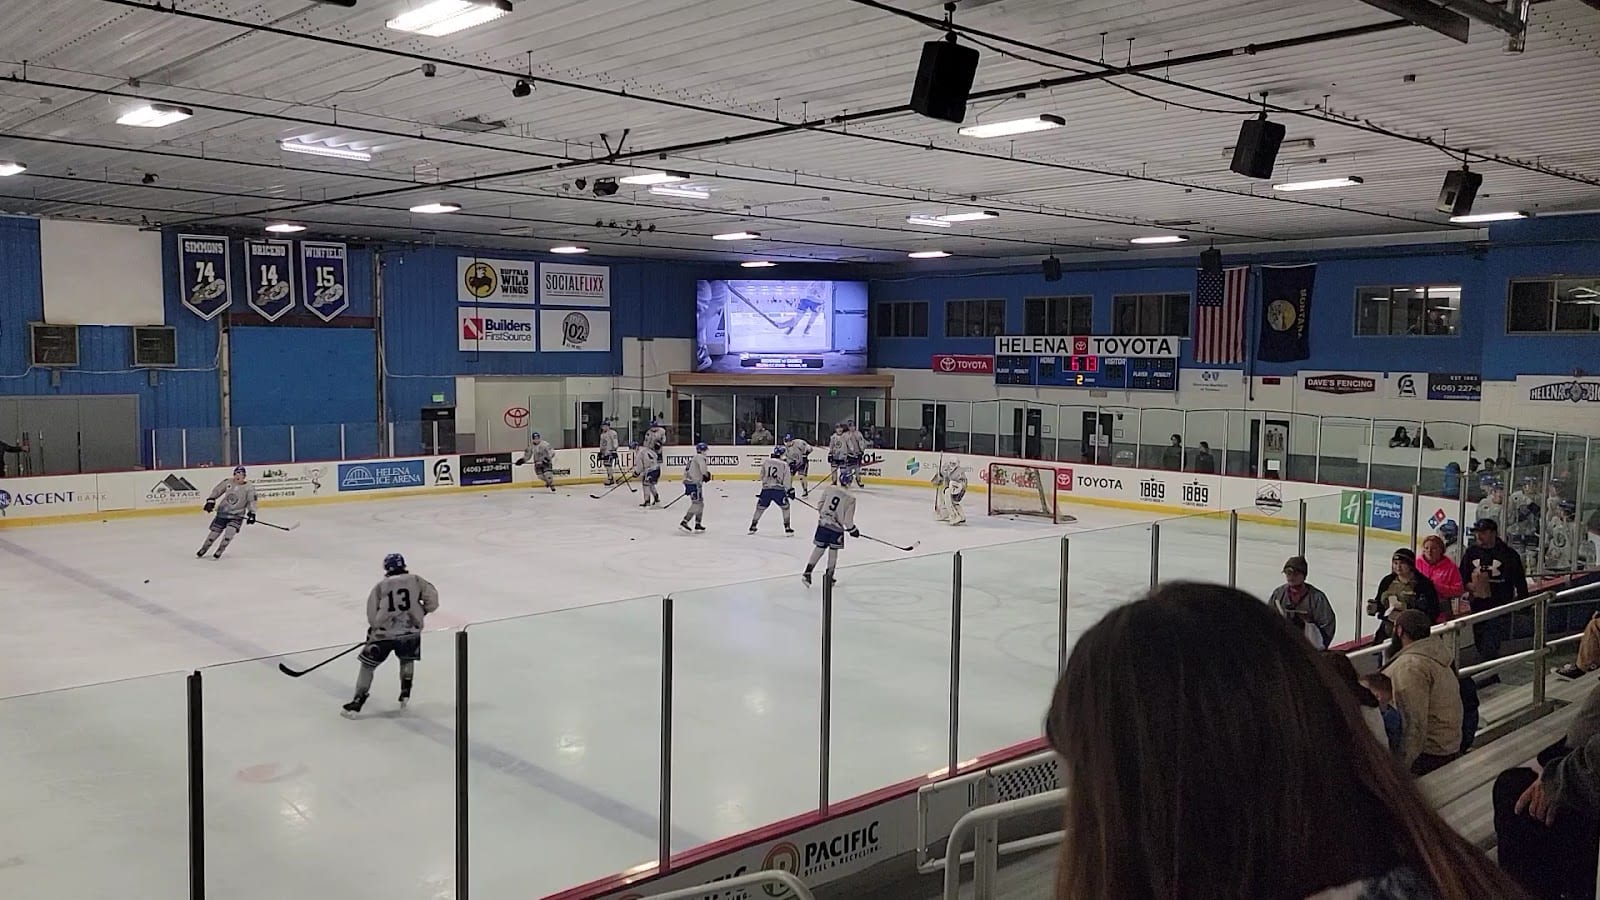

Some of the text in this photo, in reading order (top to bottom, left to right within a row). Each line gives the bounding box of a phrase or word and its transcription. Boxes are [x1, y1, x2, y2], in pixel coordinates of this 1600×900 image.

[184, 240, 224, 255] SIMMONS
[305, 246, 343, 260] WINFIELD
[195, 261, 215, 283] 74
[260, 264, 278, 286] 14
[315, 266, 335, 287] 15
[501, 275, 529, 286] WILD
[545, 274, 604, 292] SOCIALFLIXX
[501, 285, 529, 295] WINGS
[485, 318, 532, 332] Builders
[485, 331, 532, 342] FirstSource
[999, 337, 1172, 355] HELENA TOYOTA
[956, 360, 988, 370] TOYOTA
[1076, 374, 1084, 385] 2
[1307, 378, 1373, 388] DAVE'S FENCING
[1531, 384, 1564, 400] HELENA
[376, 467, 410, 477] HELENA
[376, 474, 421, 485] ICE ARENA
[766, 465, 778, 479] 12
[1077, 475, 1123, 490] TOYOTA
[77, 493, 108, 502] BANK
[1140, 482, 1165, 499] 1889
[1182, 485, 1208, 503] 1889
[13, 491, 75, 506] ASCENT
[828, 496, 841, 512] 9
[1374, 507, 1401, 519] Express
[387, 588, 411, 612] 13
[804, 820, 879, 868] PACIFIC
[804, 862, 828, 877] STEEL
